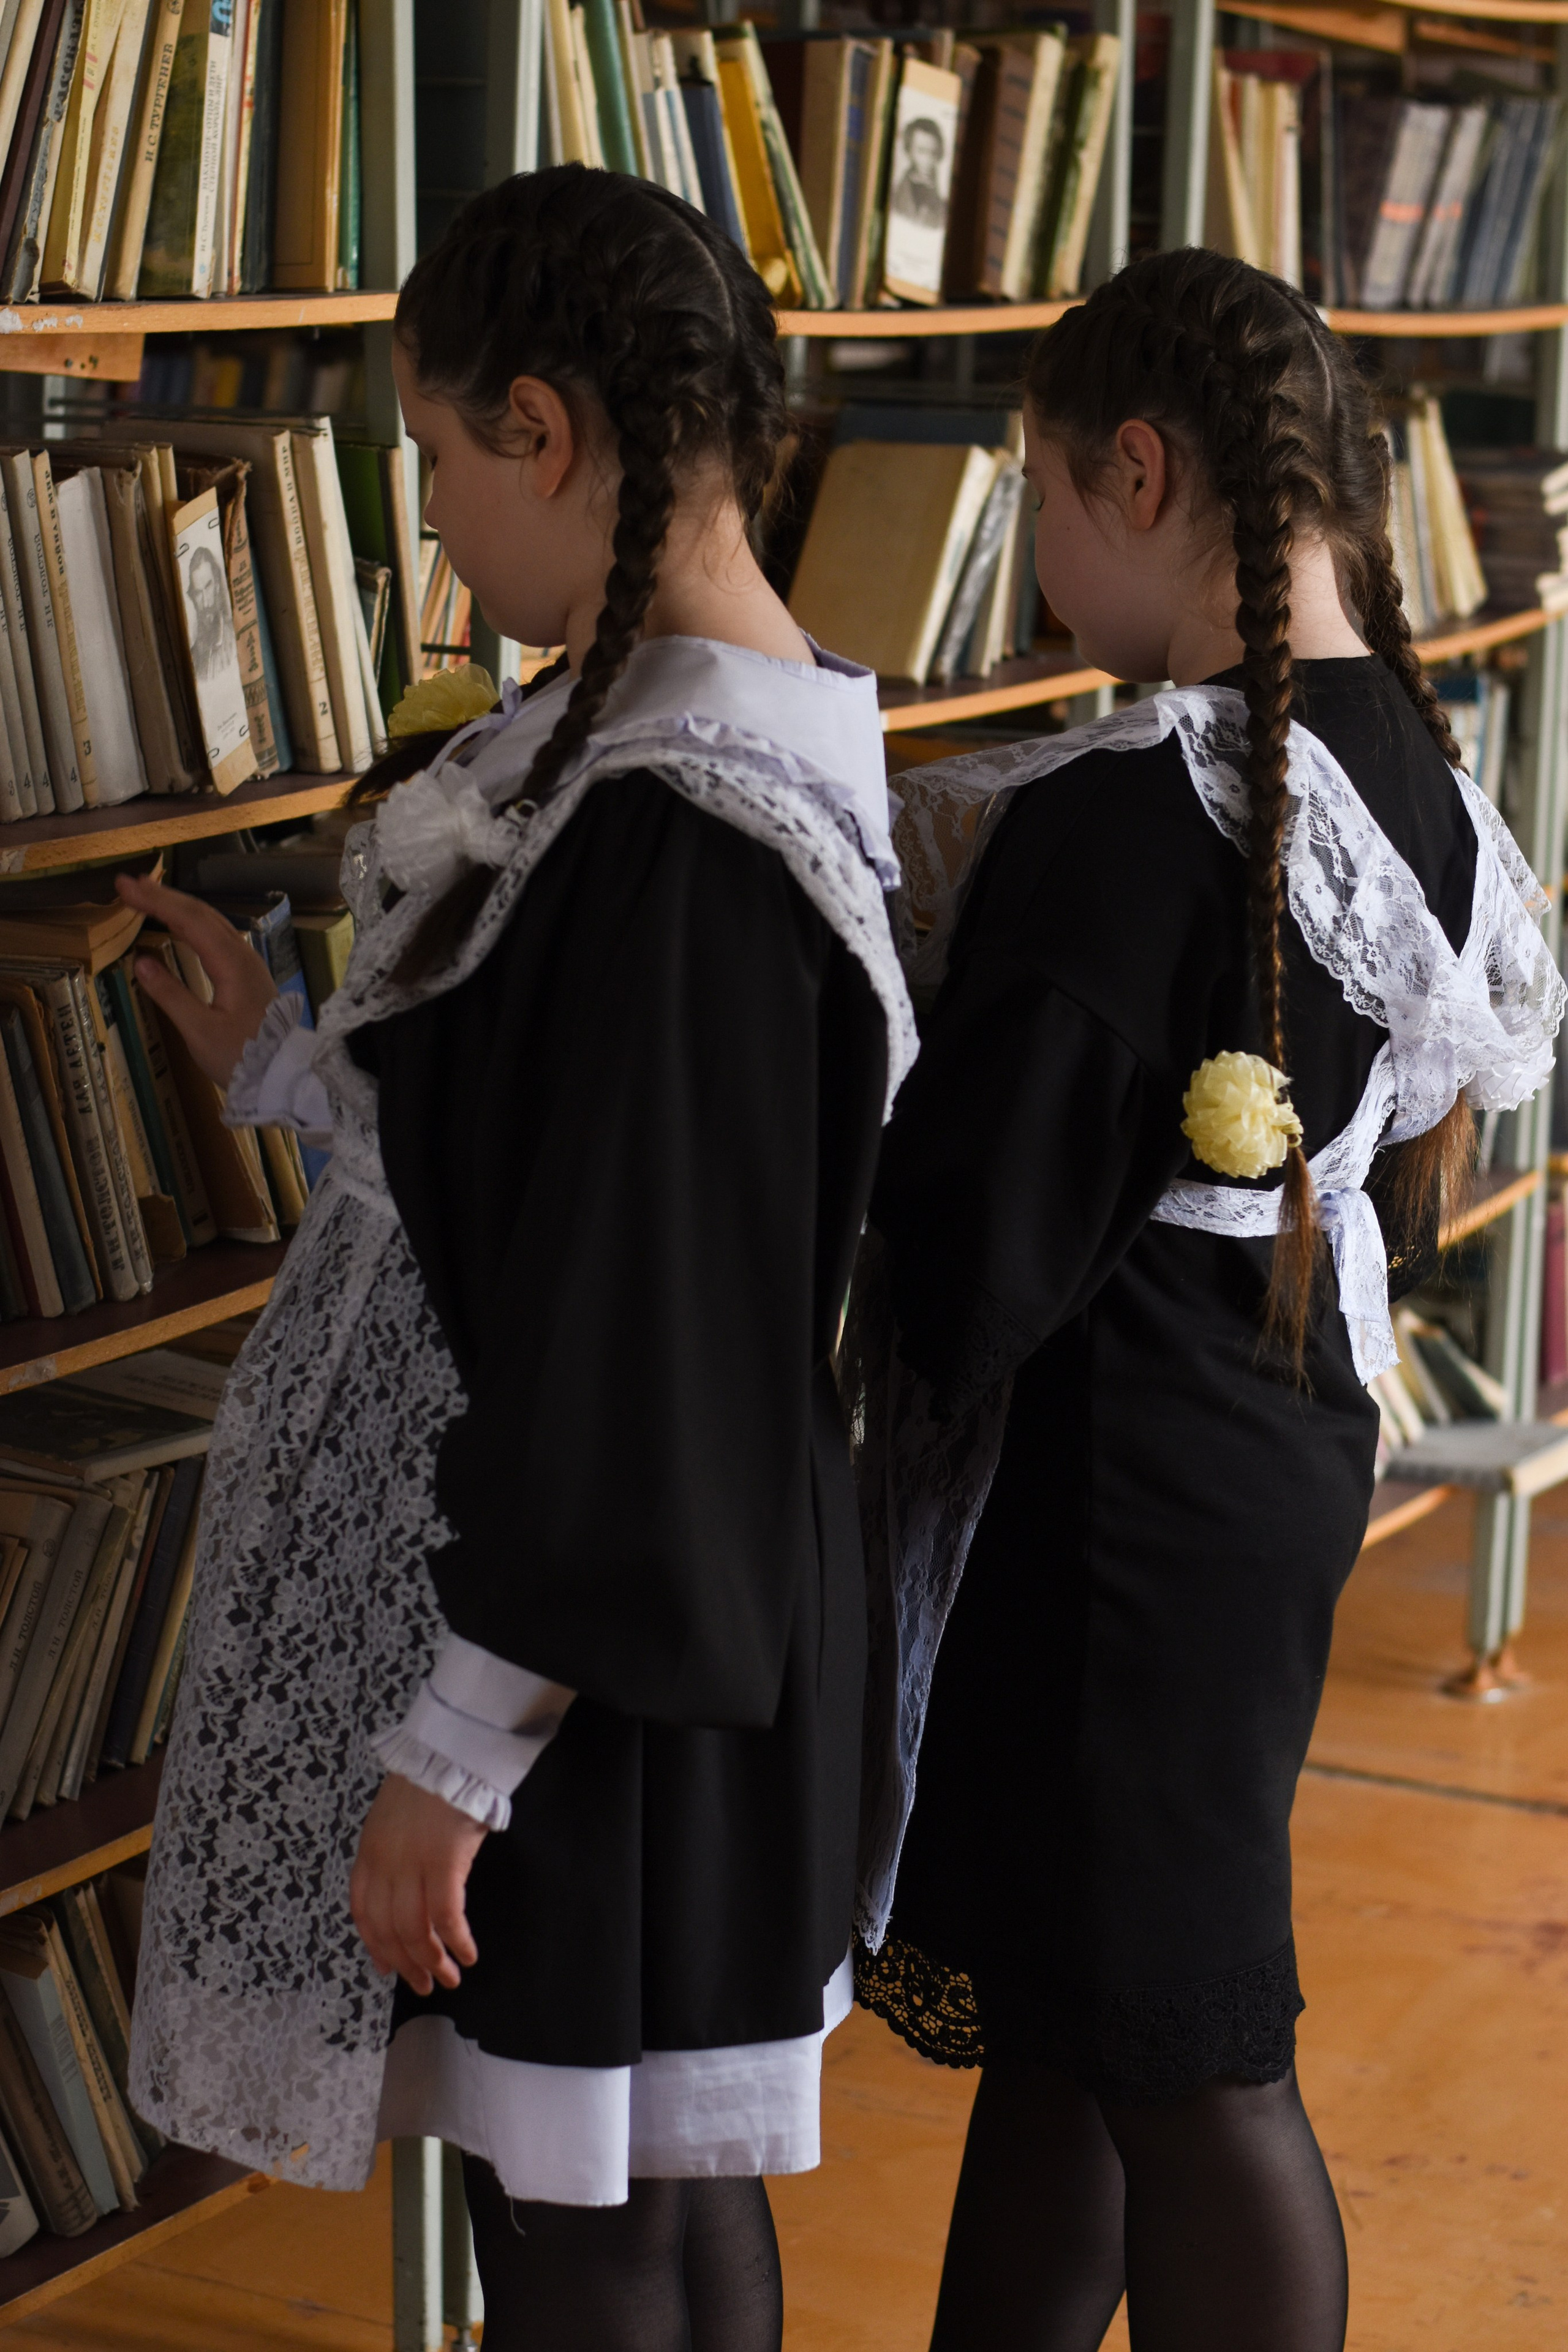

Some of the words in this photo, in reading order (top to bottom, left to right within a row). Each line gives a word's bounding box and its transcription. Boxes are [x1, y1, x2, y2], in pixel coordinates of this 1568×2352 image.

[149, 43, 173, 130] ТУРГЕНЕВ
[282, 446, 290, 478] МИР
[45, 470, 55, 505] МИР
[286, 482, 293, 491] И
[50, 508, 56, 520] И
[289, 496, 302, 545] ВОЙНА
[34, 533, 48, 597] ТОЛСТОЙ
[53, 524, 64, 576] ВОЙНА
[8, 537, 22, 601] ТОЛСТОЙ
[318, 701, 328, 717] 2
[83, 739, 92, 756] 3
[7, 780, 15, 796] 3
[23, 772, 31, 789] 4
[42, 771, 50, 788] 4
[70, 766, 78, 783] 4
[72, 1079, 93, 1114] ДЛЯ
[86, 1136, 116, 1235] ТОЛСТОЙ
[18, 1580, 43, 1641] ТОЛСТОЙ
[58, 1569, 83, 1627] ТОЛСТОЙ
